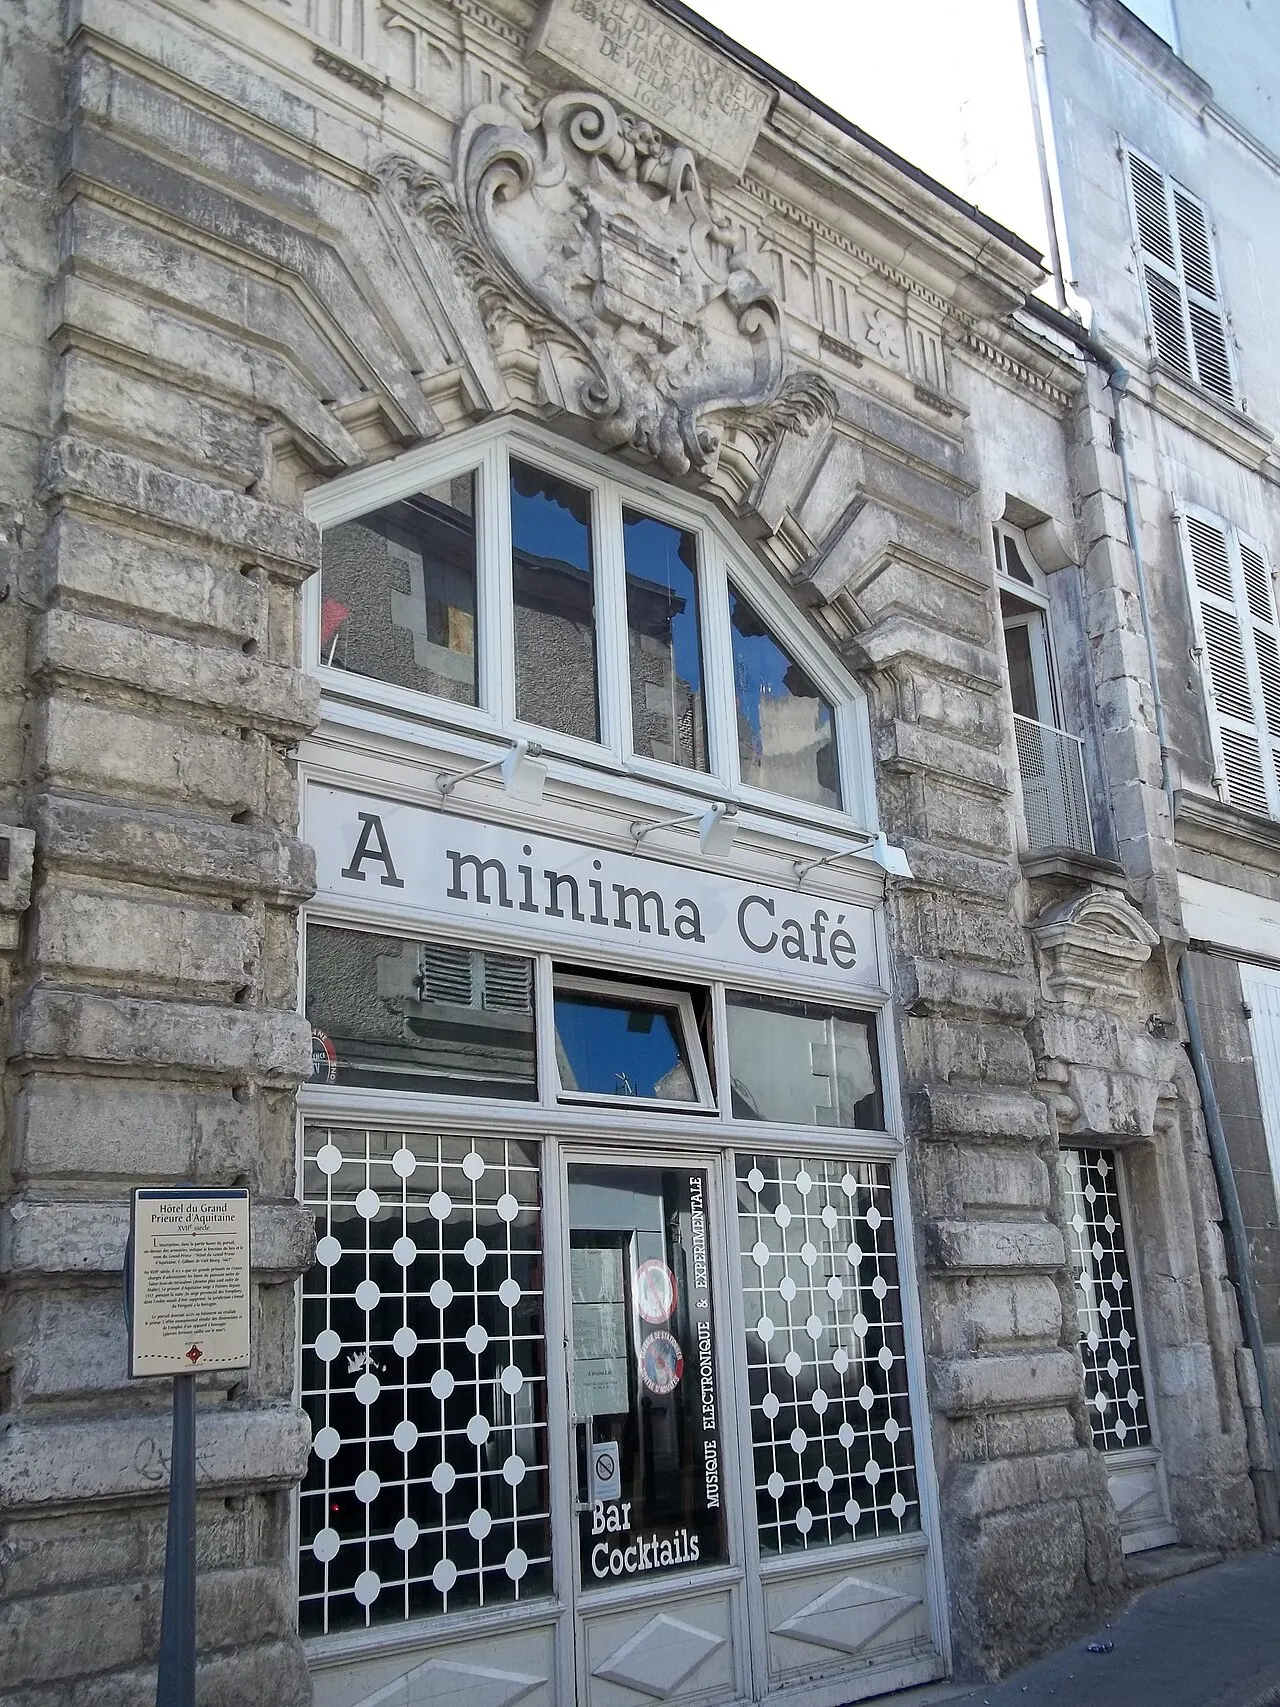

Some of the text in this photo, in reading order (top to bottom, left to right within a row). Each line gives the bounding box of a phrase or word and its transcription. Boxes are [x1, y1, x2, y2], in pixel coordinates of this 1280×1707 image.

[633, 82, 676, 116] 1667
[341, 811, 857, 970] A minima Café
[160, 1202, 227, 1213] Hôtel du Grand
[185, 1213, 236, 1224] d'Aquitaine
[690, 1177, 720, 1508] MUSIQUE ELECTRONIQUE & EXPERIMENTALE
[591, 1499, 631, 1535] Bar
[591, 1528, 700, 1579] Cocktails
